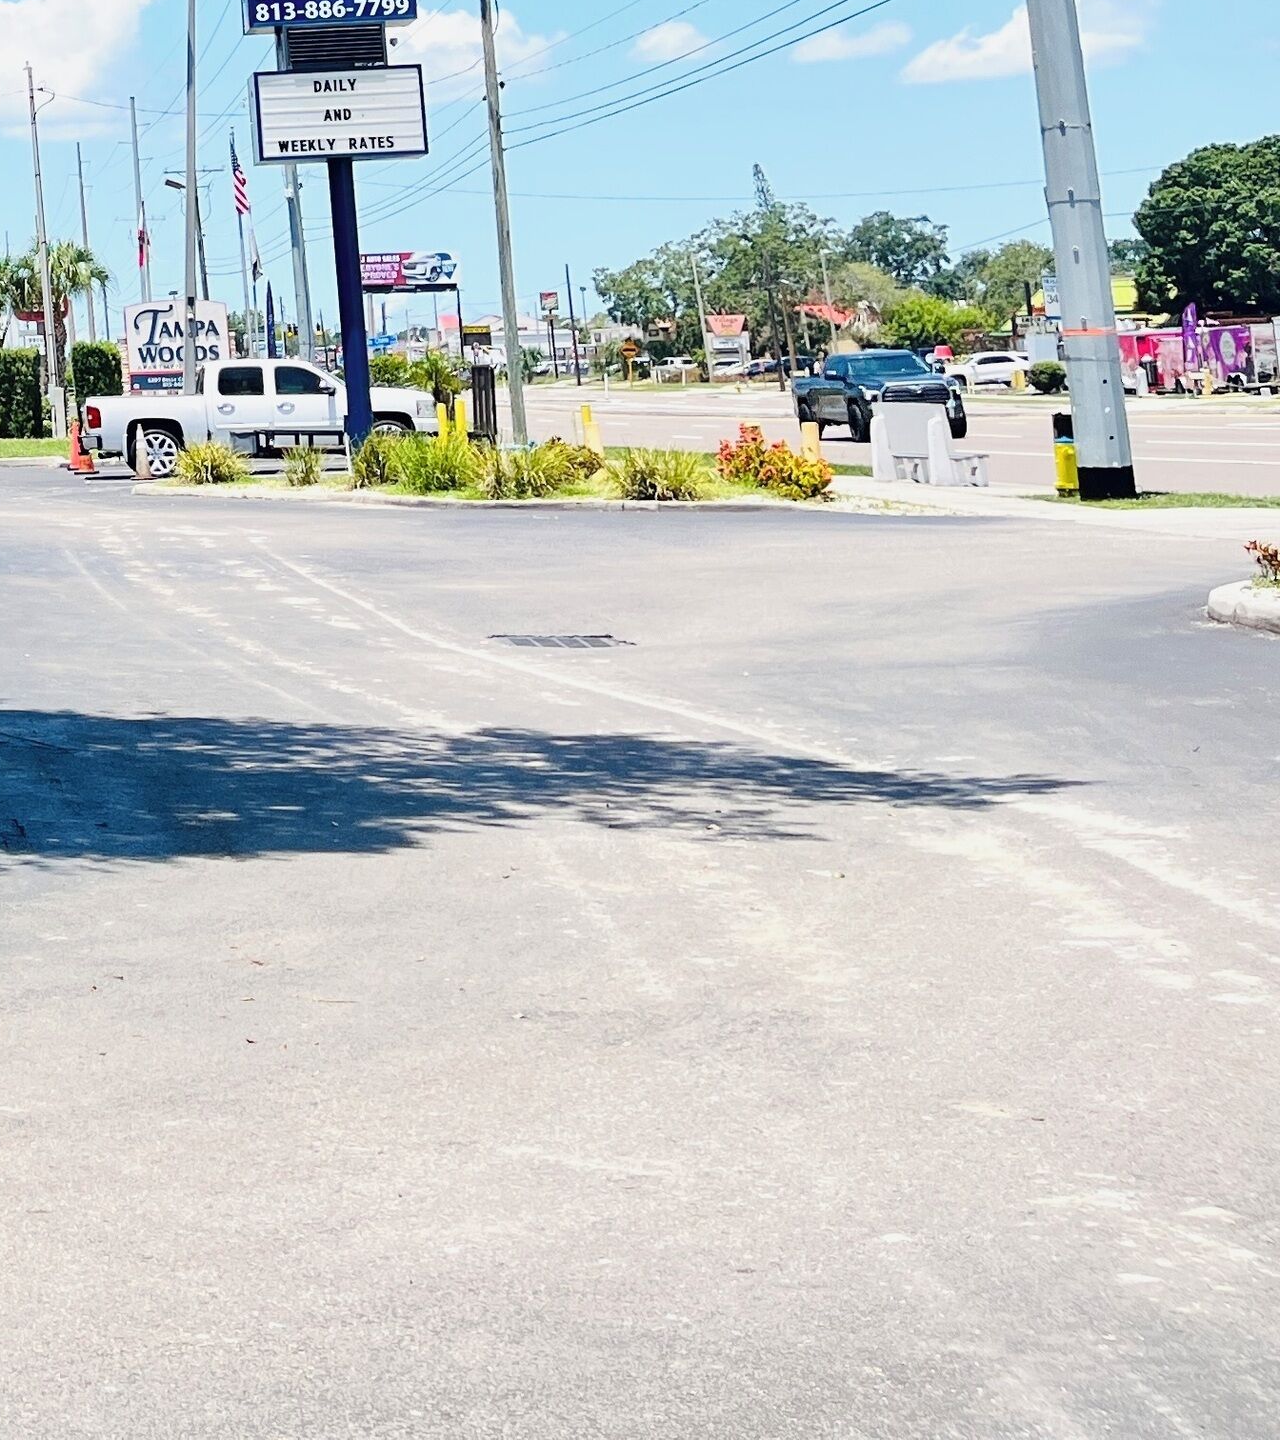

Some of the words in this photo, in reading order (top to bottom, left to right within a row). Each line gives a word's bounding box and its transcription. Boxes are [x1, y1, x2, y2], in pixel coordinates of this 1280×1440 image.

[313, 78, 357, 93] DAILY
[323, 108, 352, 122] AND
[278, 138, 336, 153] WEEKLY
[348, 136, 394, 150] RATES
[138, 345, 219, 362] WOODS
